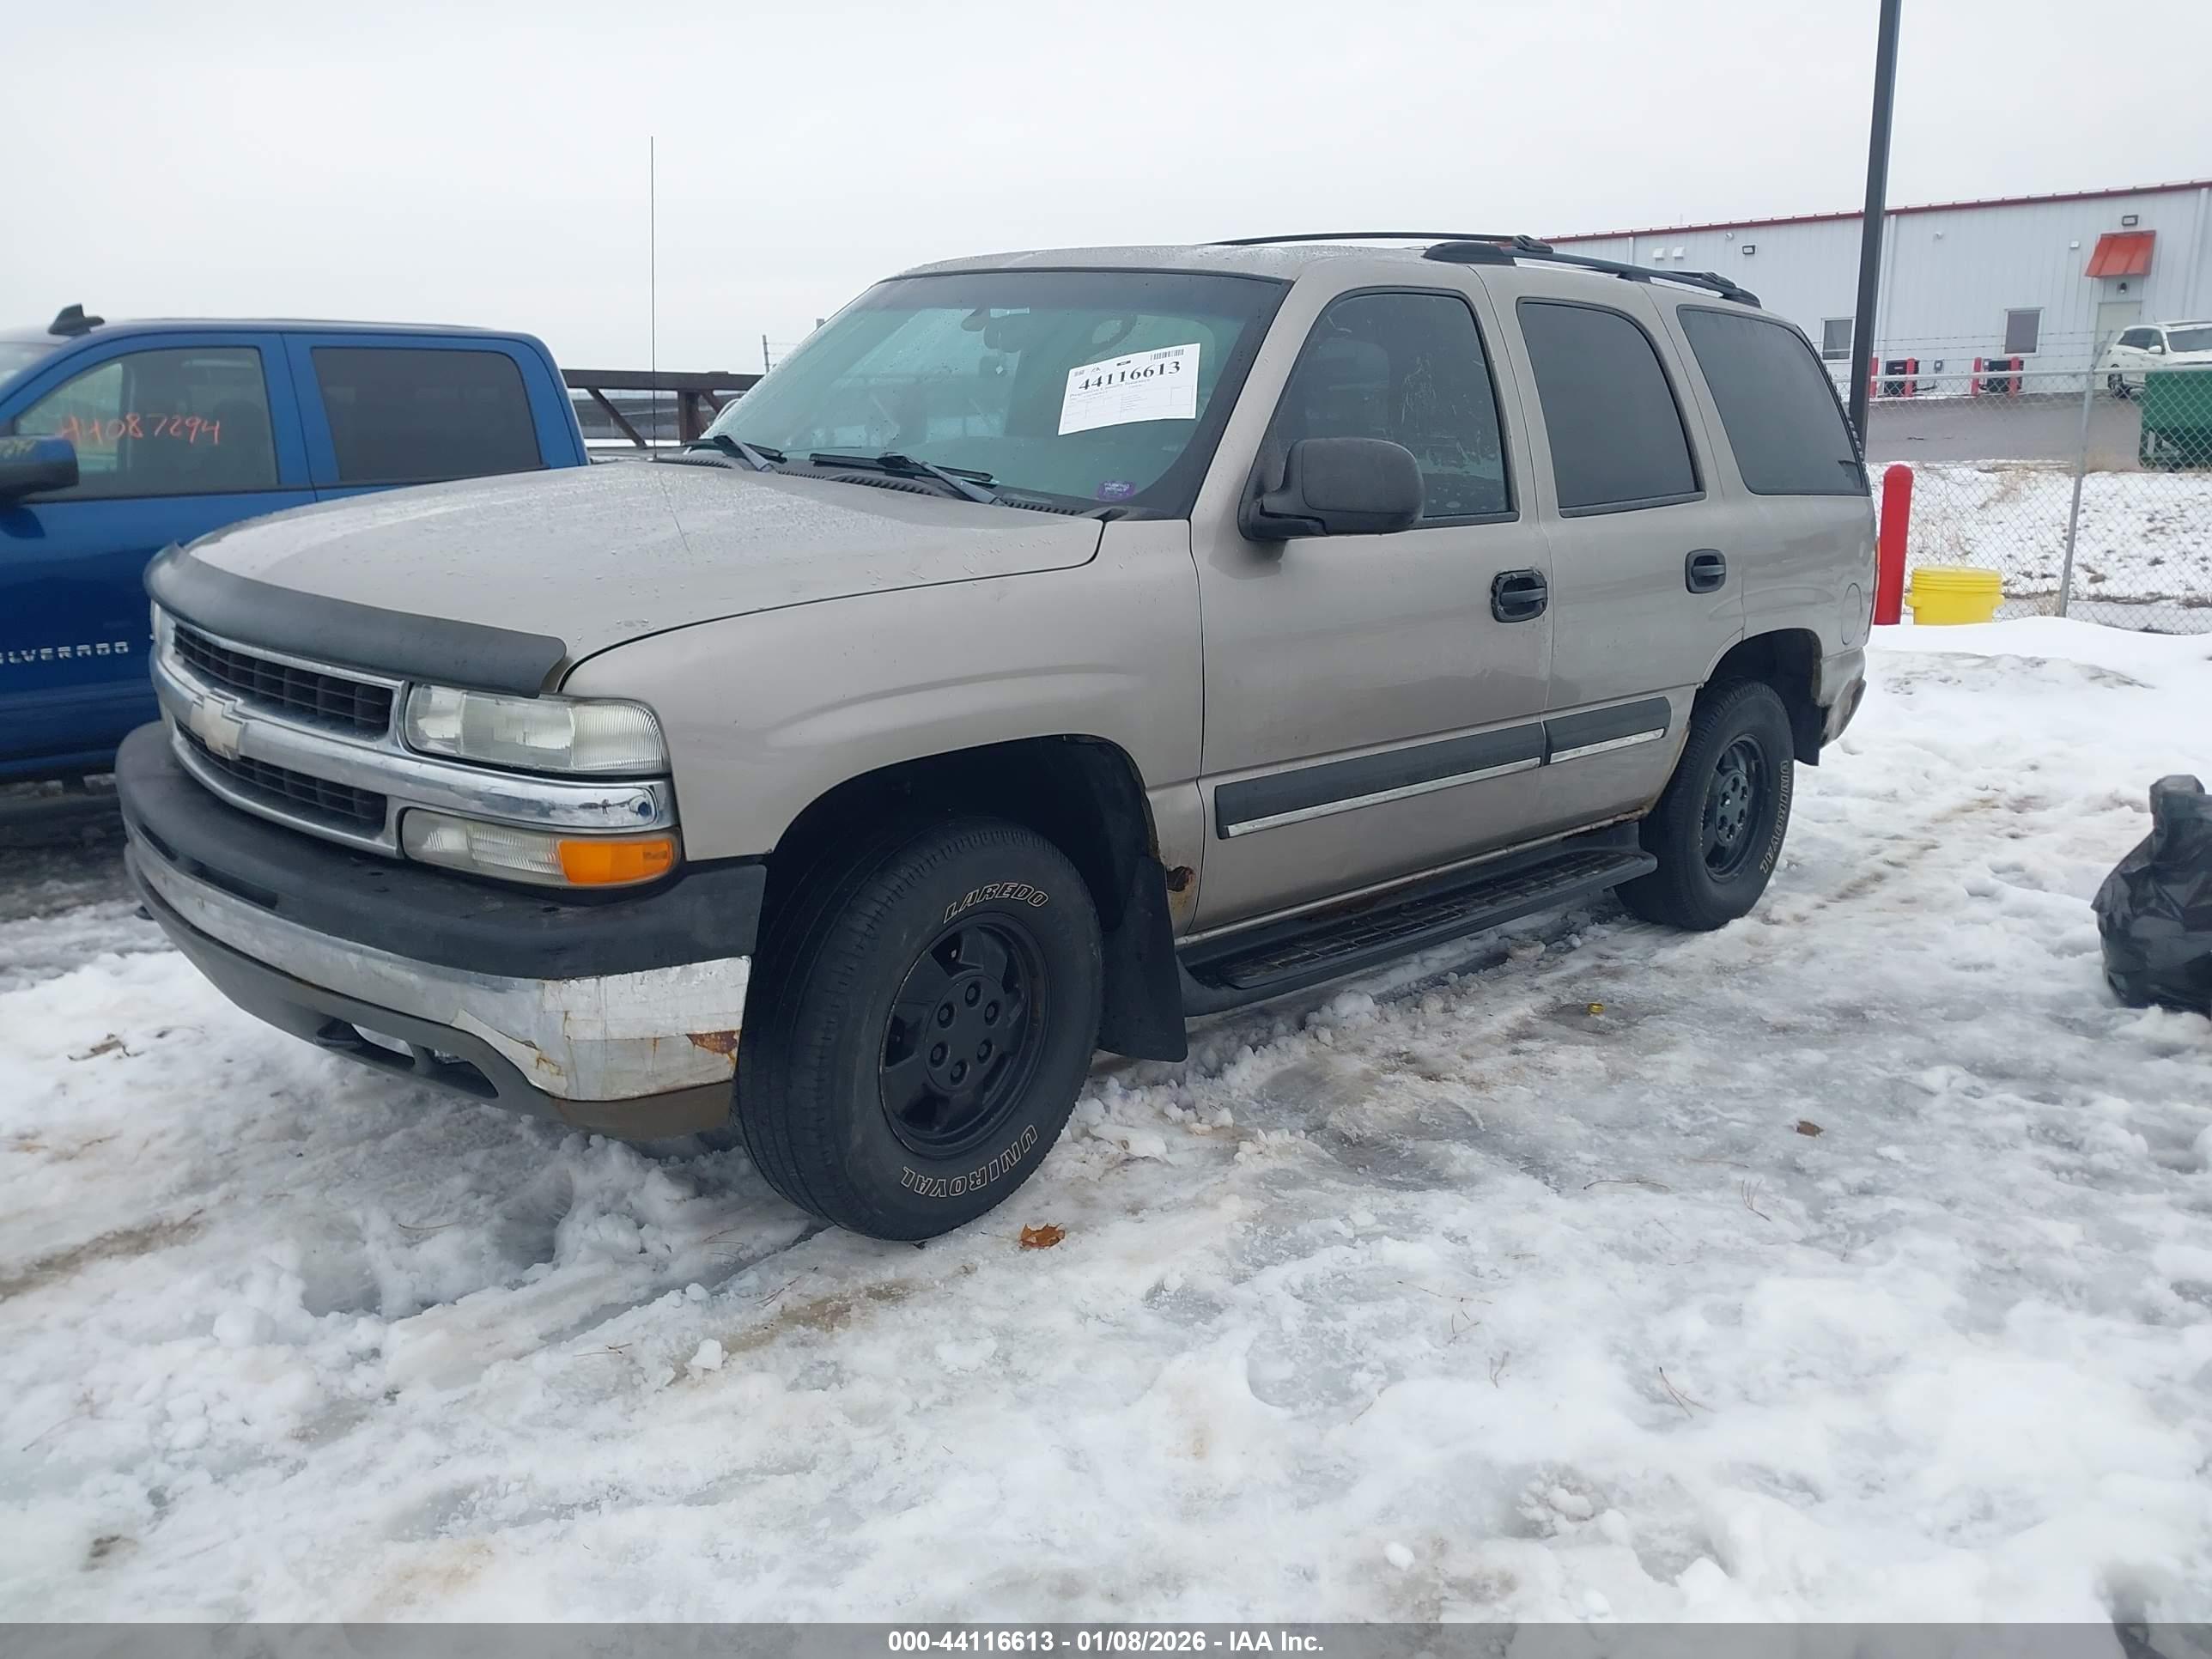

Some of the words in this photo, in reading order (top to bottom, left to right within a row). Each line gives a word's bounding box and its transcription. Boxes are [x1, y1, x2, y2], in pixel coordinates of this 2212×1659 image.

[1079, 361, 1181, 390] 44116613
[61, 412, 221, 445] 44087294
[0, 641, 129, 665] ILVERADO
[943, 882, 1049, 925] LAREDO
[900, 1124, 1038, 1198] UNIROYAL
